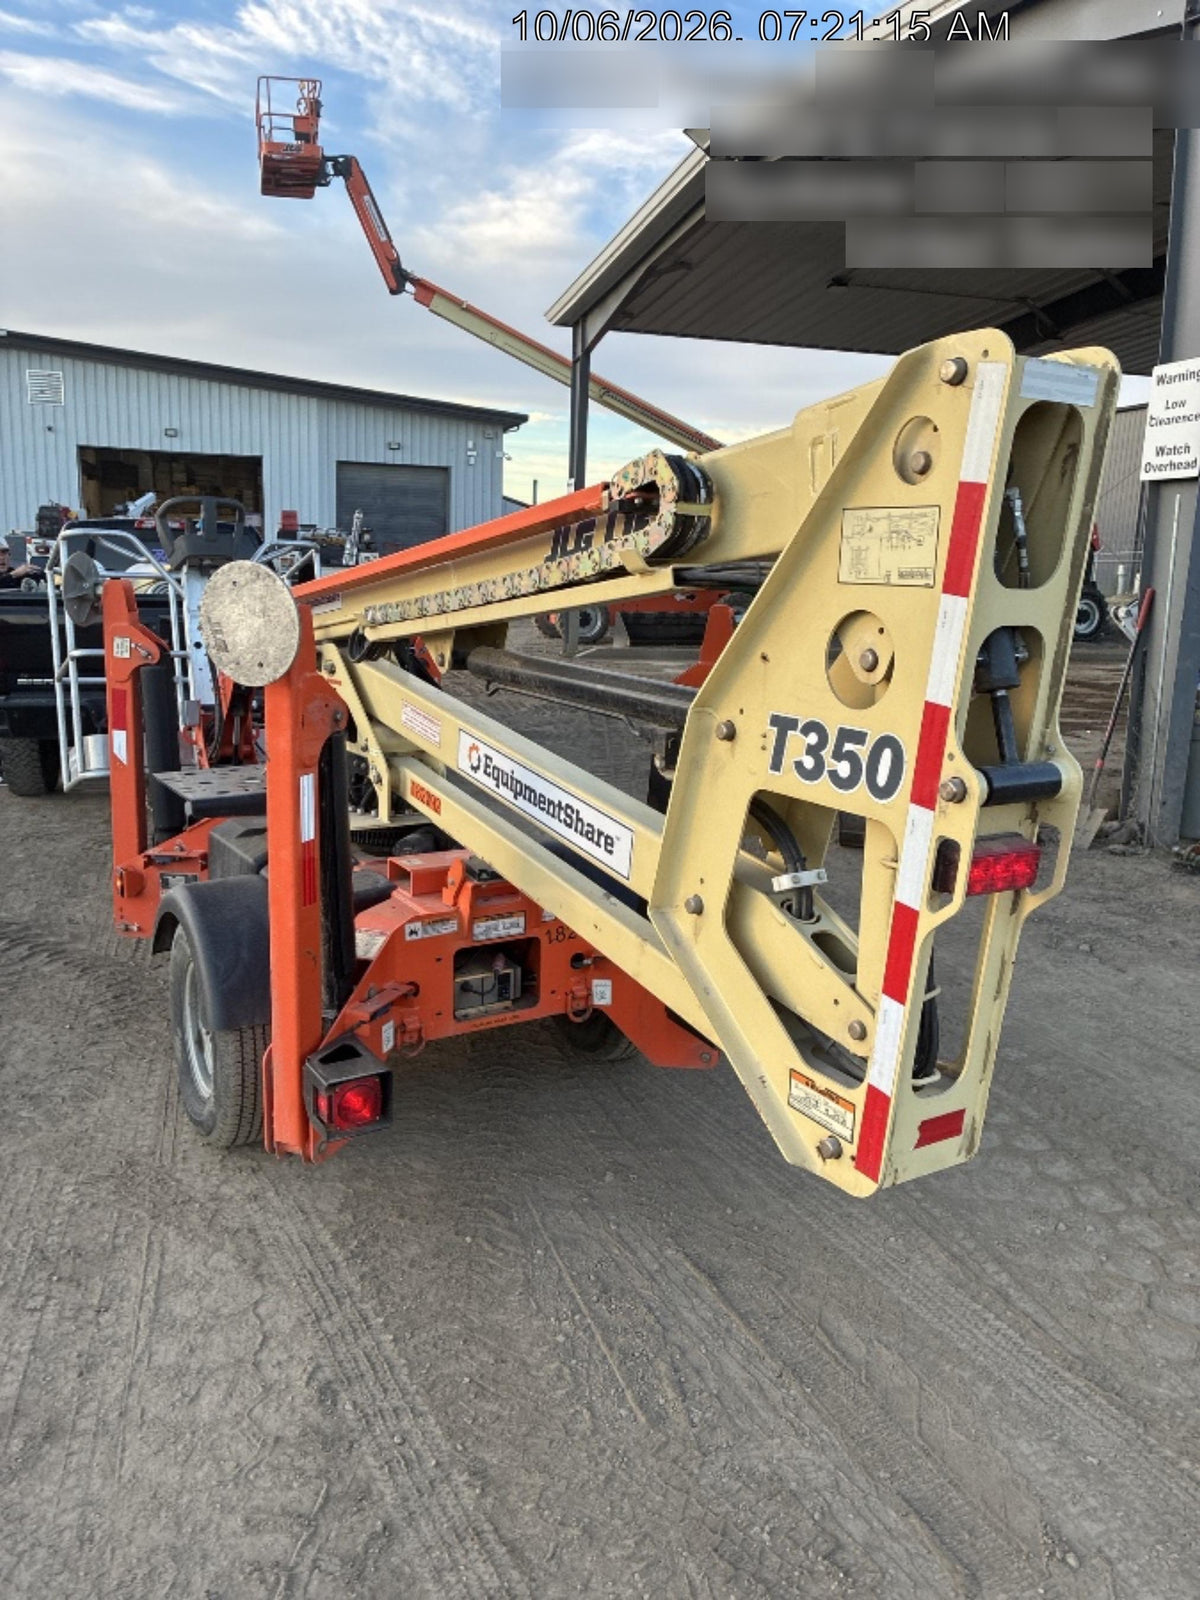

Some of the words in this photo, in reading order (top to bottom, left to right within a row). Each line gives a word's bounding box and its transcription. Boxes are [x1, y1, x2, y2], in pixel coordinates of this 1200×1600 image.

[1156, 370, 1200, 386] Warning
[1165, 399, 1187, 410] Low
[1155, 442, 1190, 457] Watch
[1144, 457, 1197, 473] Overhead
[768, 711, 905, 803] T350
[482, 753, 615, 855] EquipmentShare
